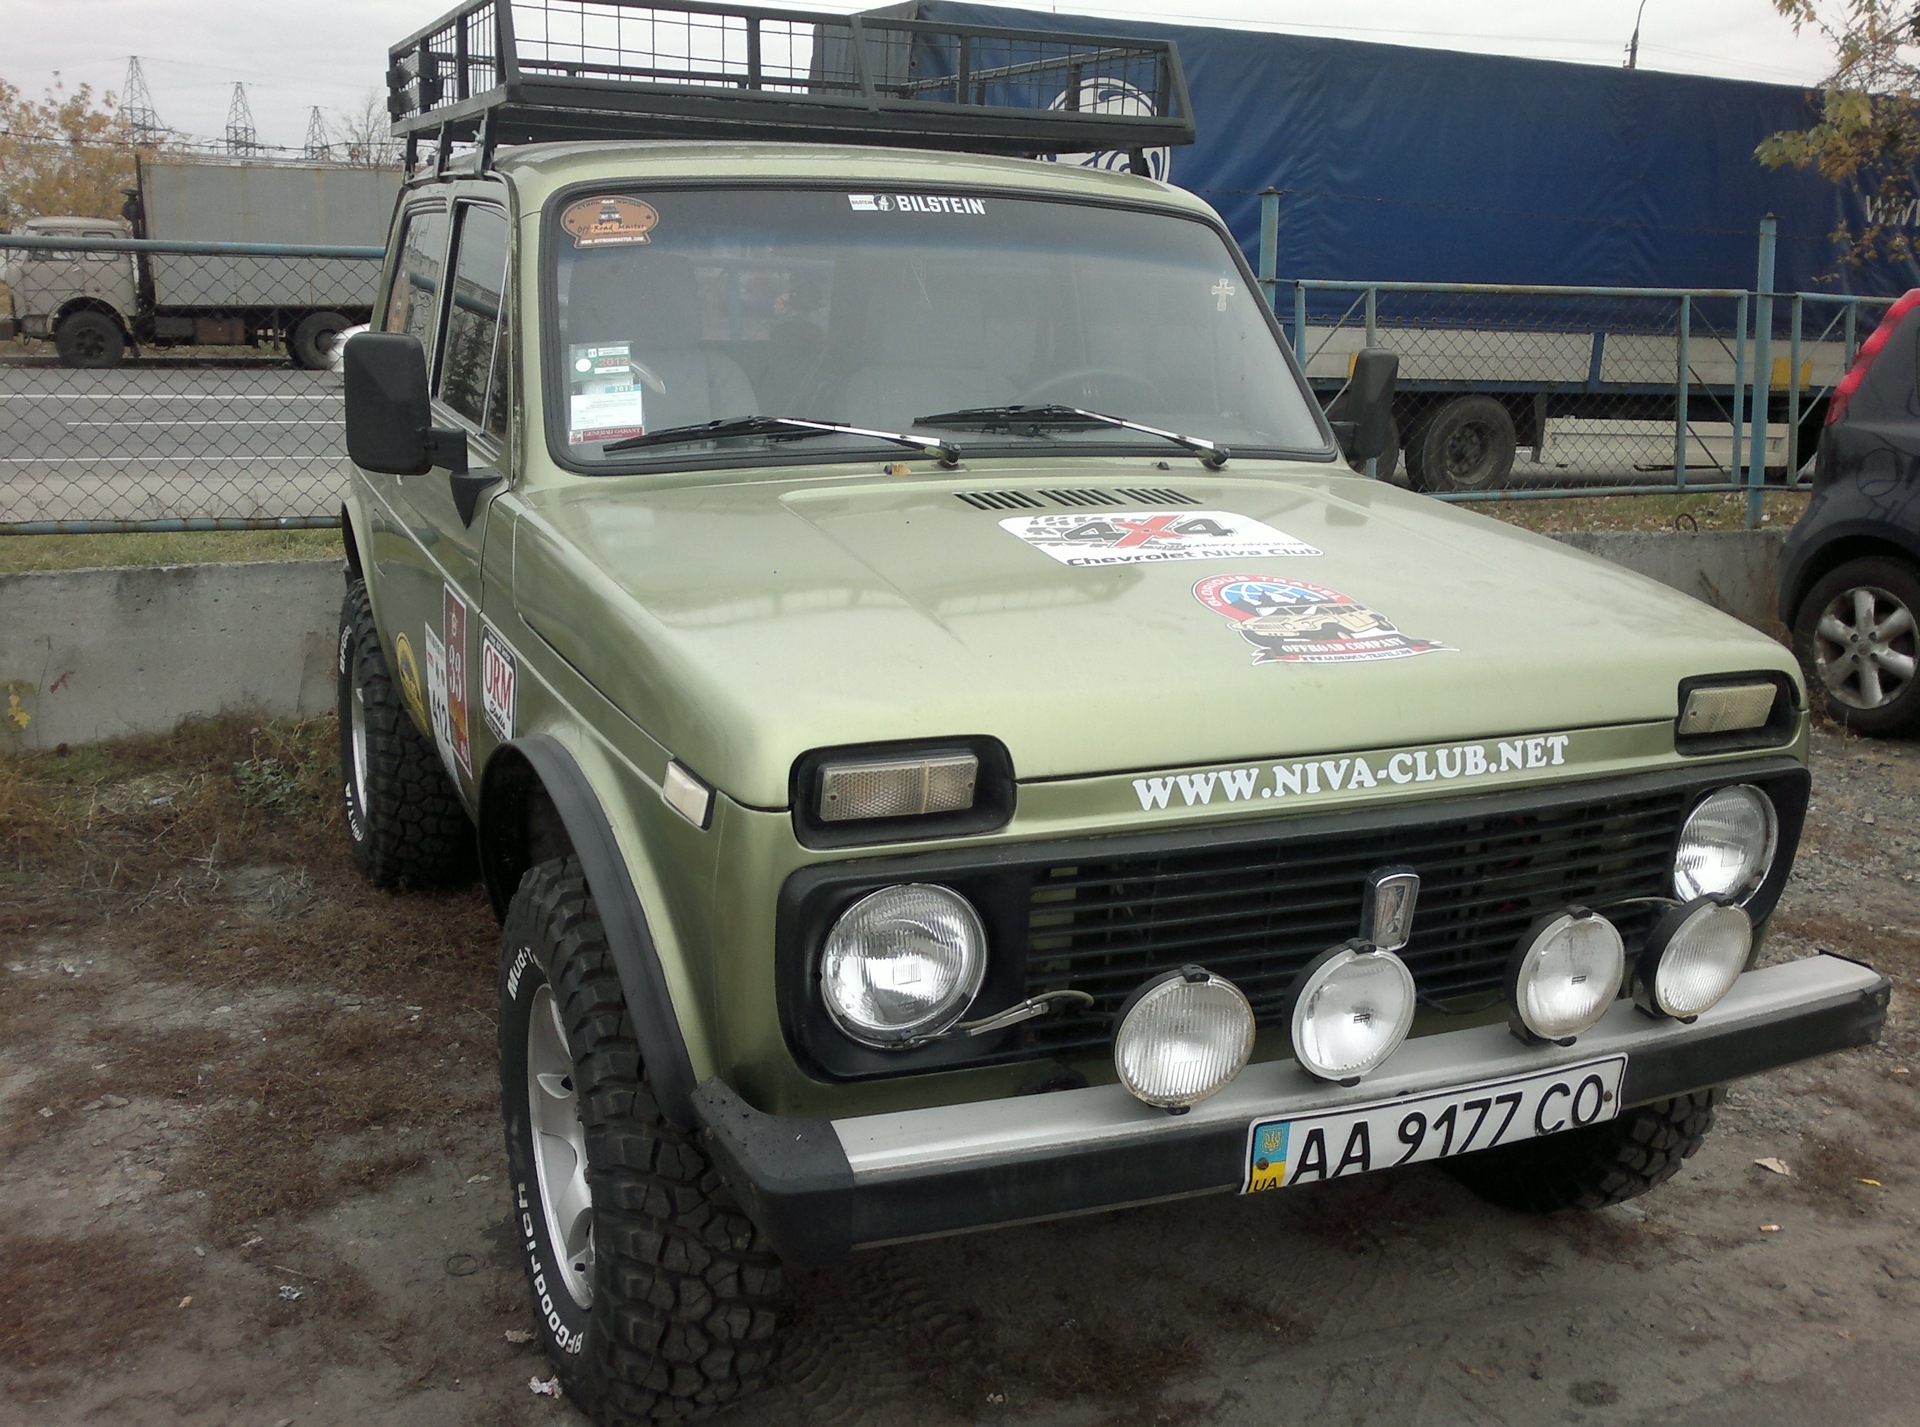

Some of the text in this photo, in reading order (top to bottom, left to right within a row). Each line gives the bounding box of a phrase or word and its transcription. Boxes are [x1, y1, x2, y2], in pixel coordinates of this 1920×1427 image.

[896, 195, 986, 215] BILSTEIN
[593, 222, 614, 232] Road
[617, 222, 646, 231] Master
[599, 357, 629, 368] 2012
[1066, 548, 1321, 566] Chevrolet Niva Club
[1200, 575, 1341, 607] GLORIOUS TRAVEL
[1281, 637, 1406, 653] OFFROAD COMPANY
[484, 643, 514, 721] ORM
[1132, 735, 1569, 812] WWW.NIVA-CLUB.NET
[1288, 1074, 1605, 1185] AA 9177 CO
[1254, 1177, 1278, 1192] UA
